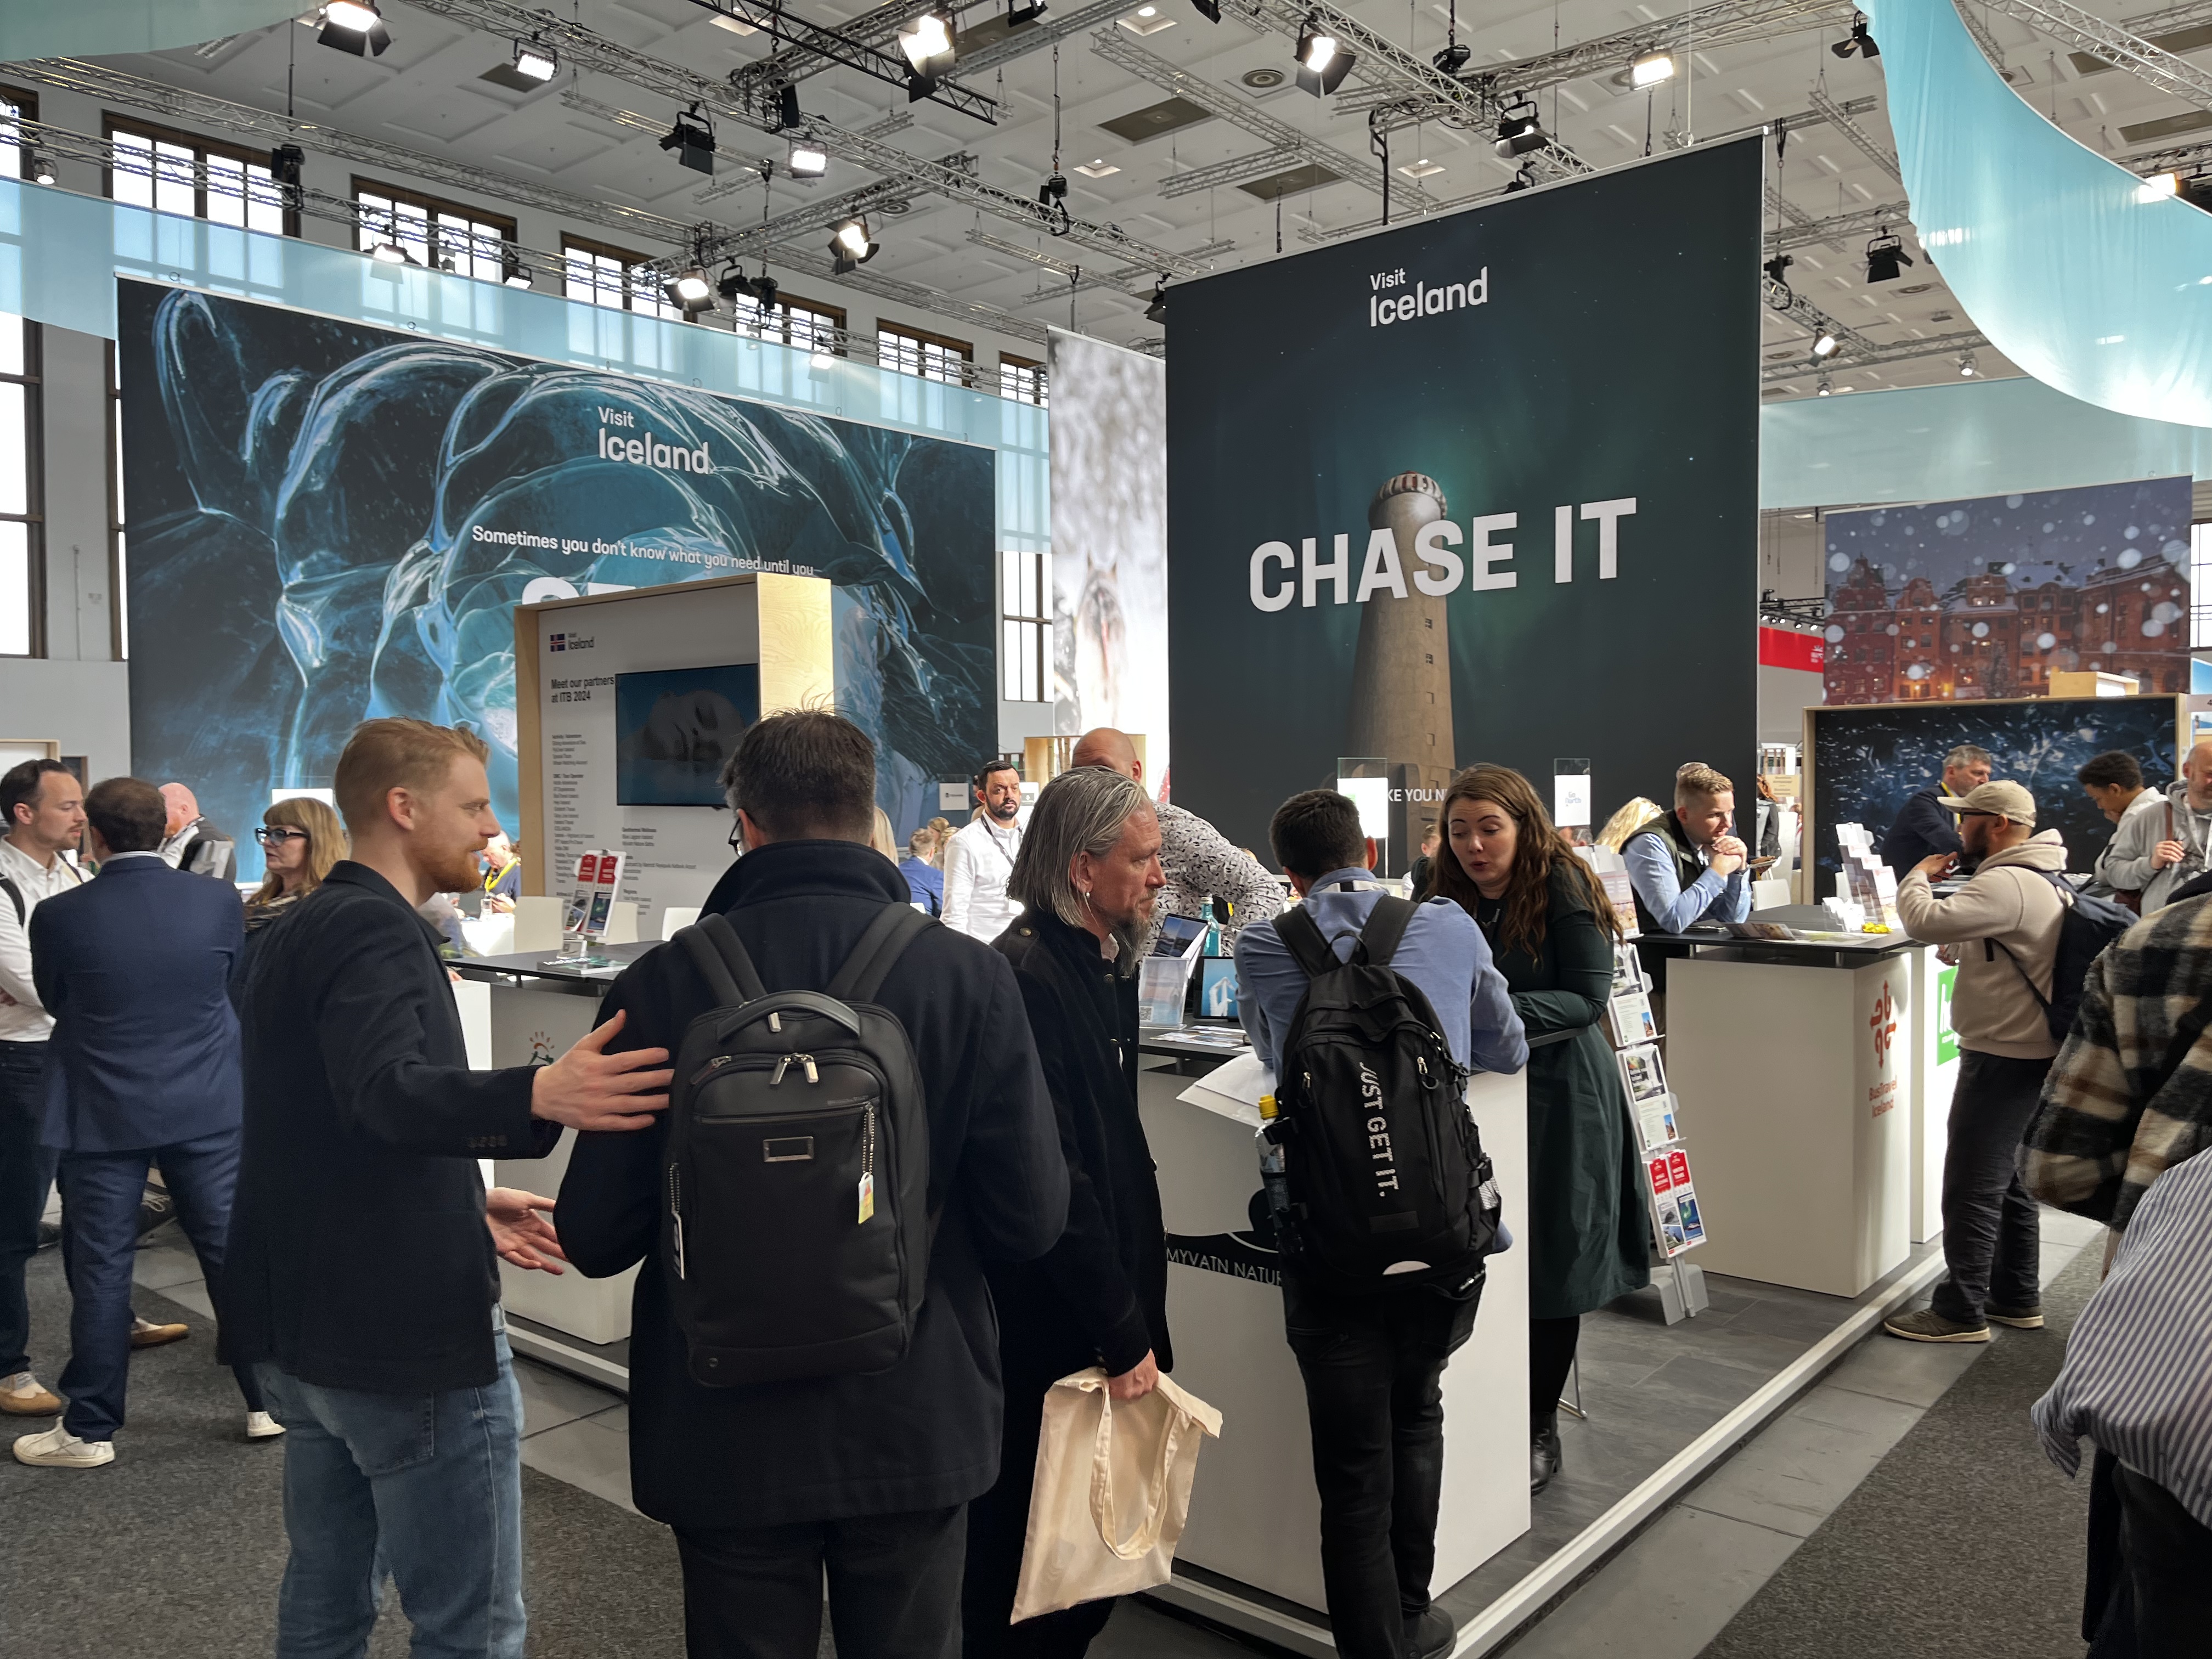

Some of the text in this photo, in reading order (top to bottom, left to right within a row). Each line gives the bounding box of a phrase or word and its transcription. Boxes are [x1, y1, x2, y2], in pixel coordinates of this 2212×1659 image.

[1370, 268, 1406, 291] Visit
[1370, 266, 1488, 328] Iceland
[597, 406, 634, 428] Visit
[599, 427, 710, 475] Iceland
[472, 524, 814, 576] Sometimes you don't know what you need until you
[1249, 497, 1637, 613] CHASE IT
[568, 636, 594, 650] Iceland
[551, 676, 614, 690] Meet our partners
[551, 690, 591, 703] at ITB 2024
[1404, 788, 1432, 802] YOU
[1871, 1094, 1894, 1119] Iceland
[1359, 1062, 1399, 1198] JUST GET IT.
[1166, 1246, 1229, 1274] MYVATN
